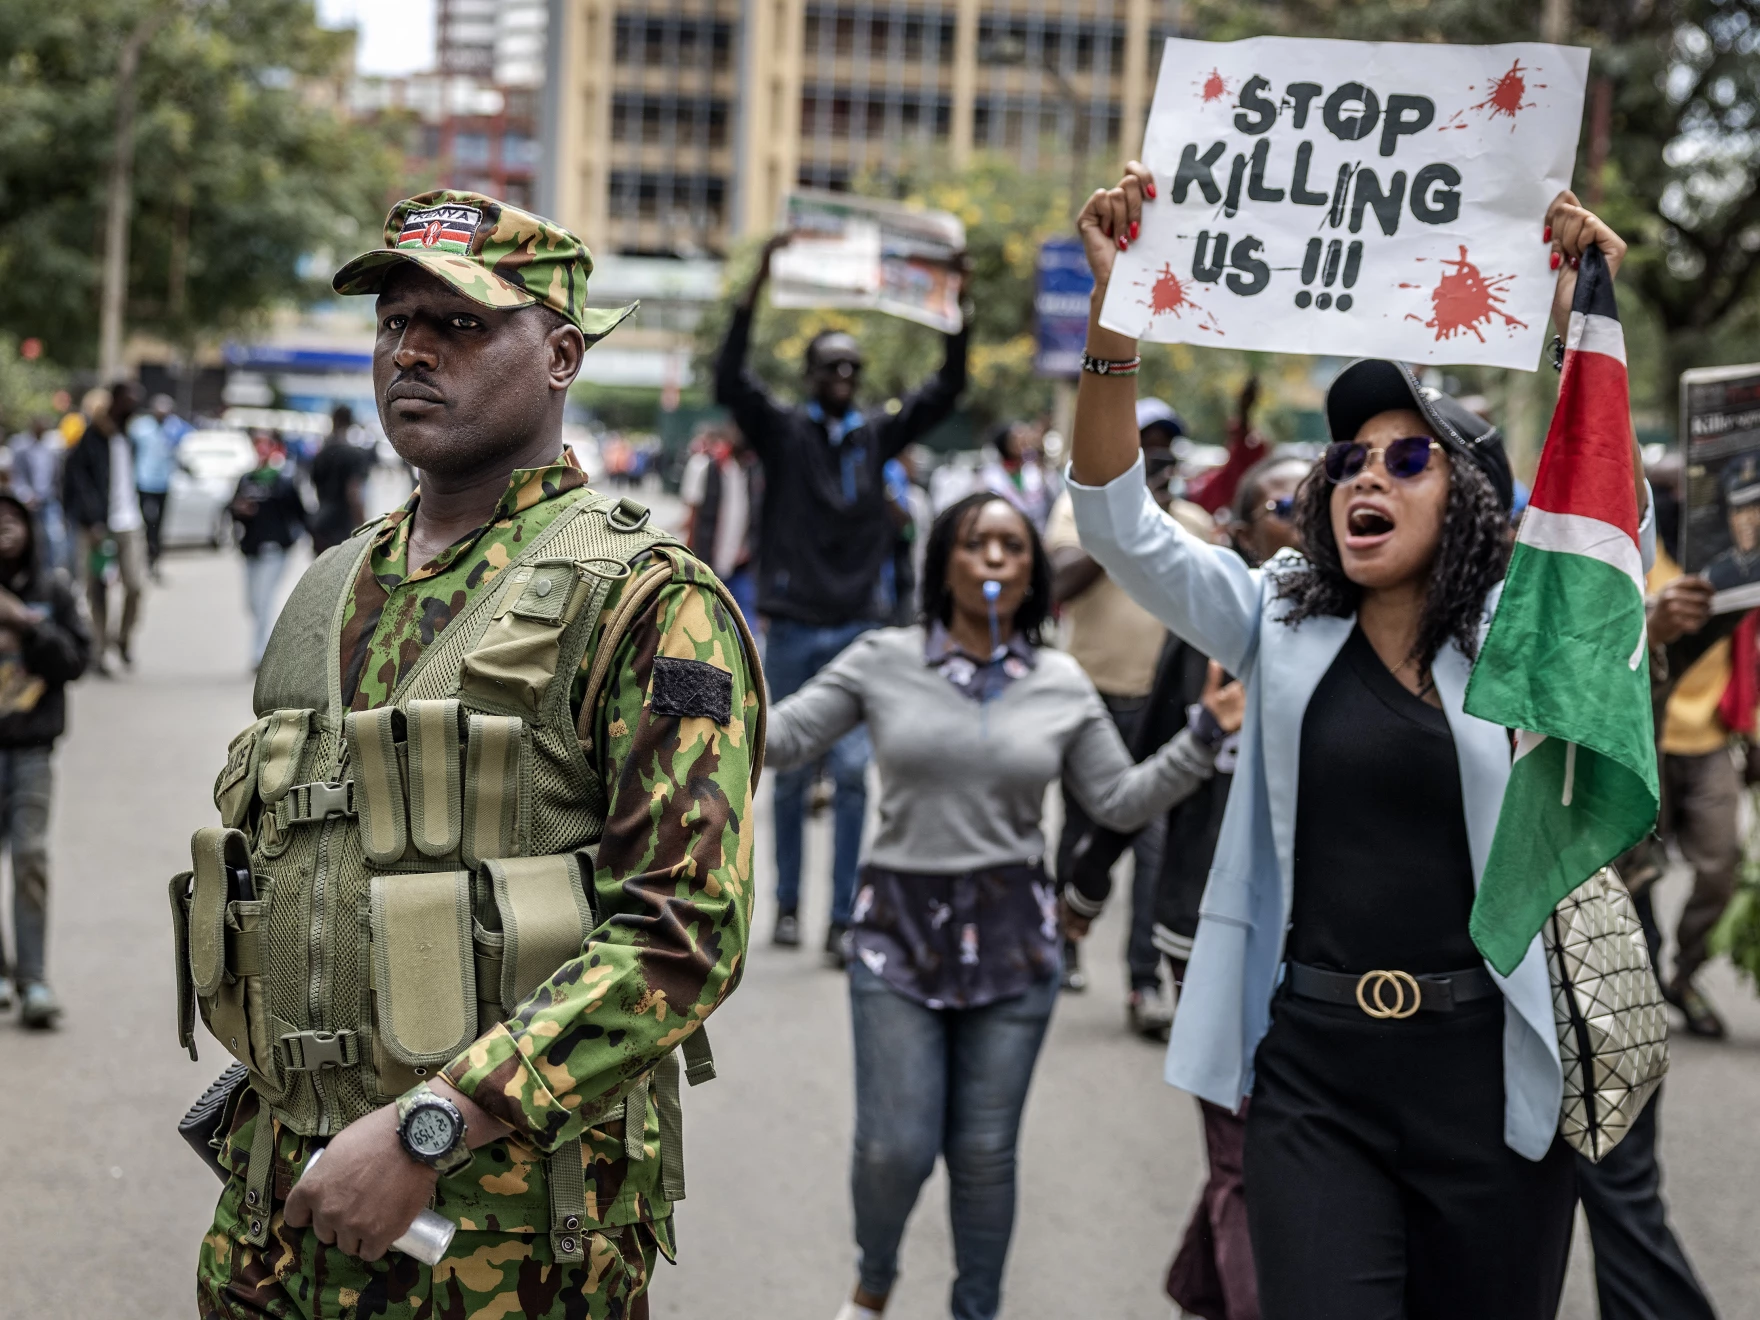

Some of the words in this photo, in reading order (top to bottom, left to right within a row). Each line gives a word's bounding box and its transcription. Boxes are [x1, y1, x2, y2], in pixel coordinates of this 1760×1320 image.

[1234, 75, 1437, 157] STOP
[413, 209, 470, 222] KENYA
[1171, 137, 1463, 236] KILLING
[1191, 230, 1271, 297] US
